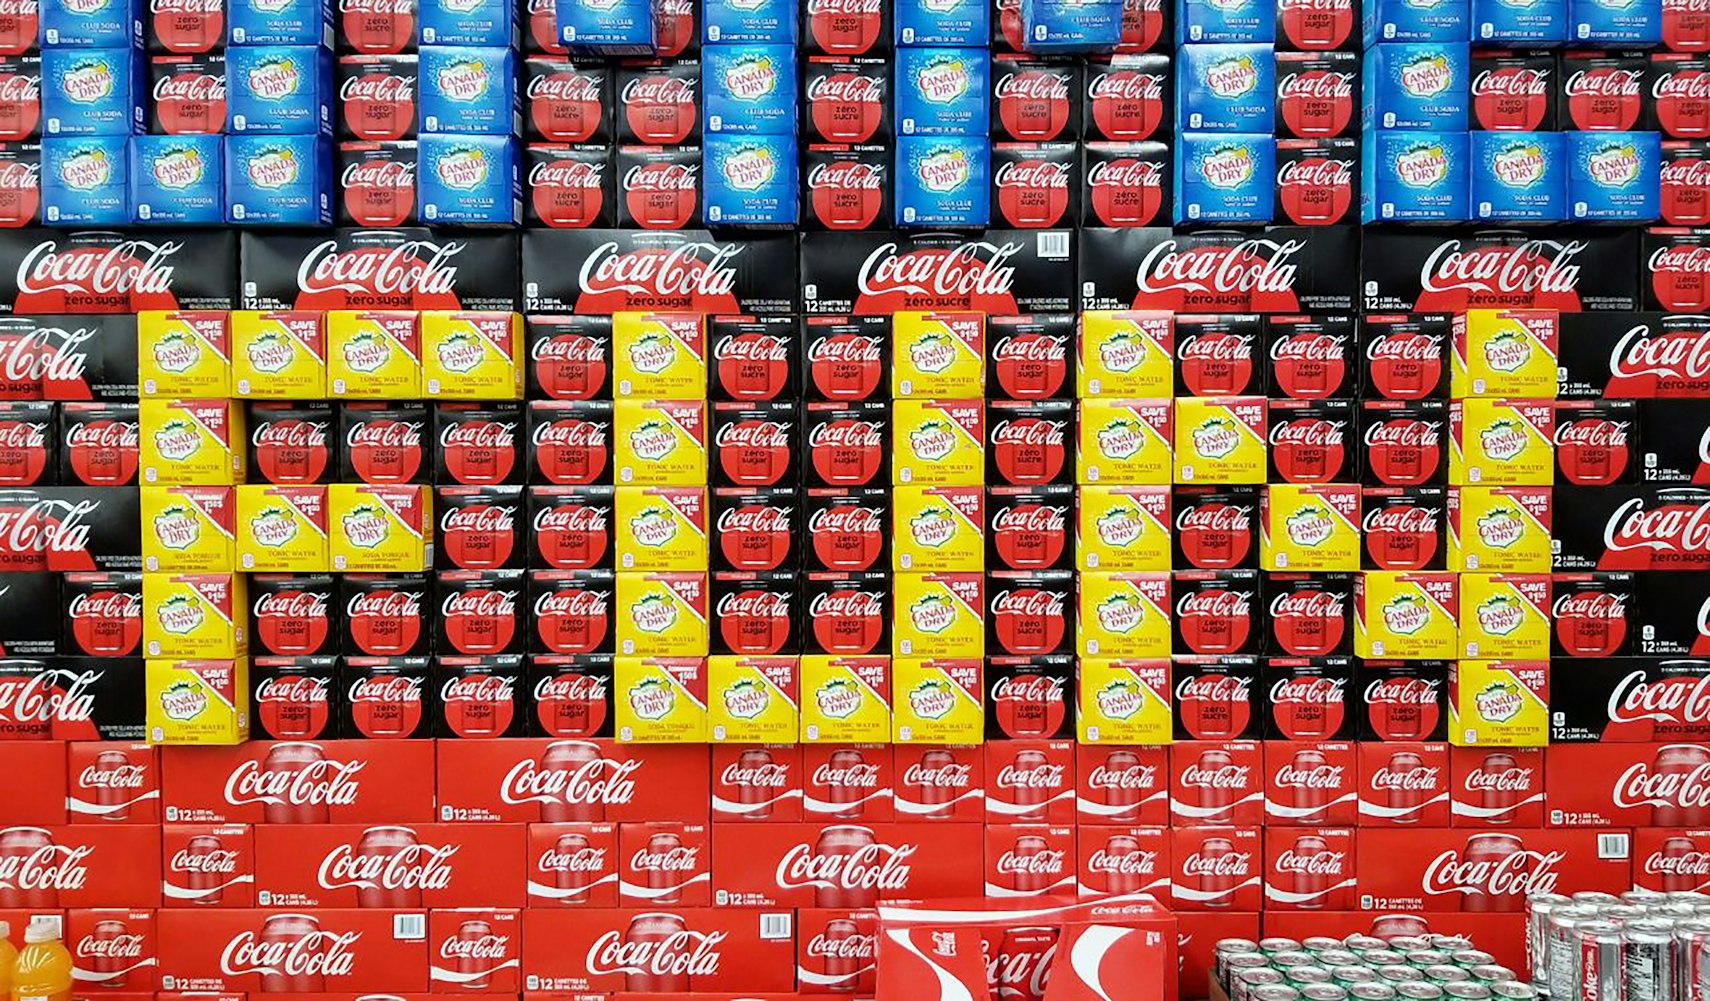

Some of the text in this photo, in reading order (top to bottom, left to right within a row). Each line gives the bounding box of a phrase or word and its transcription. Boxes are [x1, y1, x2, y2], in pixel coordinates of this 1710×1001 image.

[63, 72, 112, 89] CANADA
[249, 70, 298, 88] CANADA
[725, 67, 773, 88] CANADA
[919, 70, 966, 88] CANADA
[1278, 72, 1355, 99] Coca-Cola
[1402, 67, 1450, 86] CANADA
[1565, 70, 1644, 96] Coca-Cola
[78, 84, 101, 98] DRY
[264, 84, 287, 98] DRY
[340, 76, 416, 102] Coca-Cola
[622, 75, 697, 104] Coca-Cola
[740, 82, 764, 95] DRY
[808, 75, 884, 102] Coca-Cola
[934, 84, 956, 97] DRY
[1418, 80, 1440, 92] DRY
[1088, 159, 1164, 186] Coca-Cola
[1495, 156, 1543, 173] CANADA
[1590, 157, 1638, 174] CANADA
[995, 161, 1072, 188] Coca-Cola
[1510, 168, 1534, 180] DRY
[1605, 169, 1628, 181] DRY
[17, 239, 183, 294] Coca-Cola
[297, 239, 466, 293] Coca-Cola
[579, 242, 745, 295] Coca-Cola
[858, 242, 1025, 295] Coca-Cola
[1137, 239, 1306, 293] Coca-Cola
[1421, 240, 1588, 292] Coca-Cola
[64, 295, 130, 308] zero sugar
[244, 298, 258, 310] 12
[345, 296, 413, 307] zero sugar
[526, 299, 539, 310] 12
[626, 296, 693, 308] zero sugar
[806, 301, 818, 312] 12
[904, 296, 971, 307] zéro sucre
[1082, 298, 1096, 309] 12
[1184, 294, 1252, 306] zero sugar
[1365, 297, 1378, 309] 12
[1467, 294, 1535, 307] zero sugar
[195, 320, 221, 329] SAVE
[289, 321, 316, 330] SAVE
[386, 320, 412, 329] SAVE
[480, 322, 506, 331] SAVE
[671, 322, 697, 331] SAVE
[952, 322, 979, 331] SAVE
[1527, 319, 1553, 328] SAVE
[250, 342, 294, 362] CANADA
[438, 343, 484, 363] CANADA
[532, 337, 608, 361] Coca-Cola
[714, 335, 791, 361] Coca-Cola
[808, 336, 884, 362] Coca-Cola
[912, 344, 955, 362] CANADA
[992, 335, 1069, 361] Coca-Cola
[1178, 335, 1255, 360] Coca-Cola
[1270, 335, 1348, 360] Coca-Cola
[263, 355, 285, 366] DRY
[452, 356, 476, 367] DRY
[923, 357, 946, 367] DRY
[253, 422, 328, 447] Coca-Cola
[533, 421, 608, 446] Coca-Cola
[991, 420, 1067, 445] Coca-Cola
[1365, 421, 1442, 446] Coca-Cola
[1553, 421, 1630, 449] Coca-Cola
[294, 495, 320, 505] SAVE
[674, 496, 698, 505] SAVE
[952, 495, 978, 505] SAVE
[1330, 493, 1356, 504] SAVE
[156, 519, 200, 536] CANADA
[441, 506, 516, 532] Coca-Cola
[534, 506, 609, 531] Coca-Cola
[809, 506, 884, 533] Coca-Cola
[1287, 518, 1333, 536] CANADA
[1363, 508, 1440, 532] Coca-Cola
[169, 527, 191, 540] DRY
[834, 534, 857, 542] zero
[1300, 529, 1324, 540] DRY
[200, 583, 225, 593] SAVE
[674, 582, 698, 592] SAVE
[952, 582, 978, 591] SAVE
[1520, 583, 1547, 593] SAVE
[347, 592, 423, 617] Coca-Cola
[717, 592, 792, 617] Coca-Cola
[810, 592, 885, 617] Coca-Cola
[991, 590, 1067, 616] Coca-Cola
[1270, 592, 1347, 617] Coca-Cola
[1642, 641, 1654, 653] 12
[766, 668, 791, 678] SAVE
[858, 667, 884, 678] SAVE
[951, 667, 977, 678] SAVE
[1176, 676, 1252, 701] Coca-Cola
[1270, 678, 1347, 703] Coca-Cola
[1364, 679, 1440, 703] Coca-Cola
[1553, 727, 1566, 739] 12
[79, 765, 146, 787] Coca-Cola
[225, 761, 366, 805] Coca-Cola
[501, 759, 642, 804] Coca-Cola
[721, 764, 789, 786] Coca-Cola
[1372, 765, 1438, 790] Coca-Cola
[178, 809, 192, 821] 12
[454, 808, 467, 820] 12
[1565, 813, 1577, 824] 12
[318, 844, 459, 889] Coca-Cola
[539, 847, 606, 872] Coca-Cola
[776, 844, 917, 889] Coca-Cola
[997, 850, 1064, 874] Coca-Cola
[1423, 850, 1565, 899] Coca-Cola
[271, 894, 284, 905] 12
[729, 893, 742, 905] 12
[1374, 898, 1387, 909] 12
[77, 935, 145, 958] Coca-Cola
[221, 931, 361, 975] Coca-Cola
[586, 930, 727, 975] Coca-Cola
